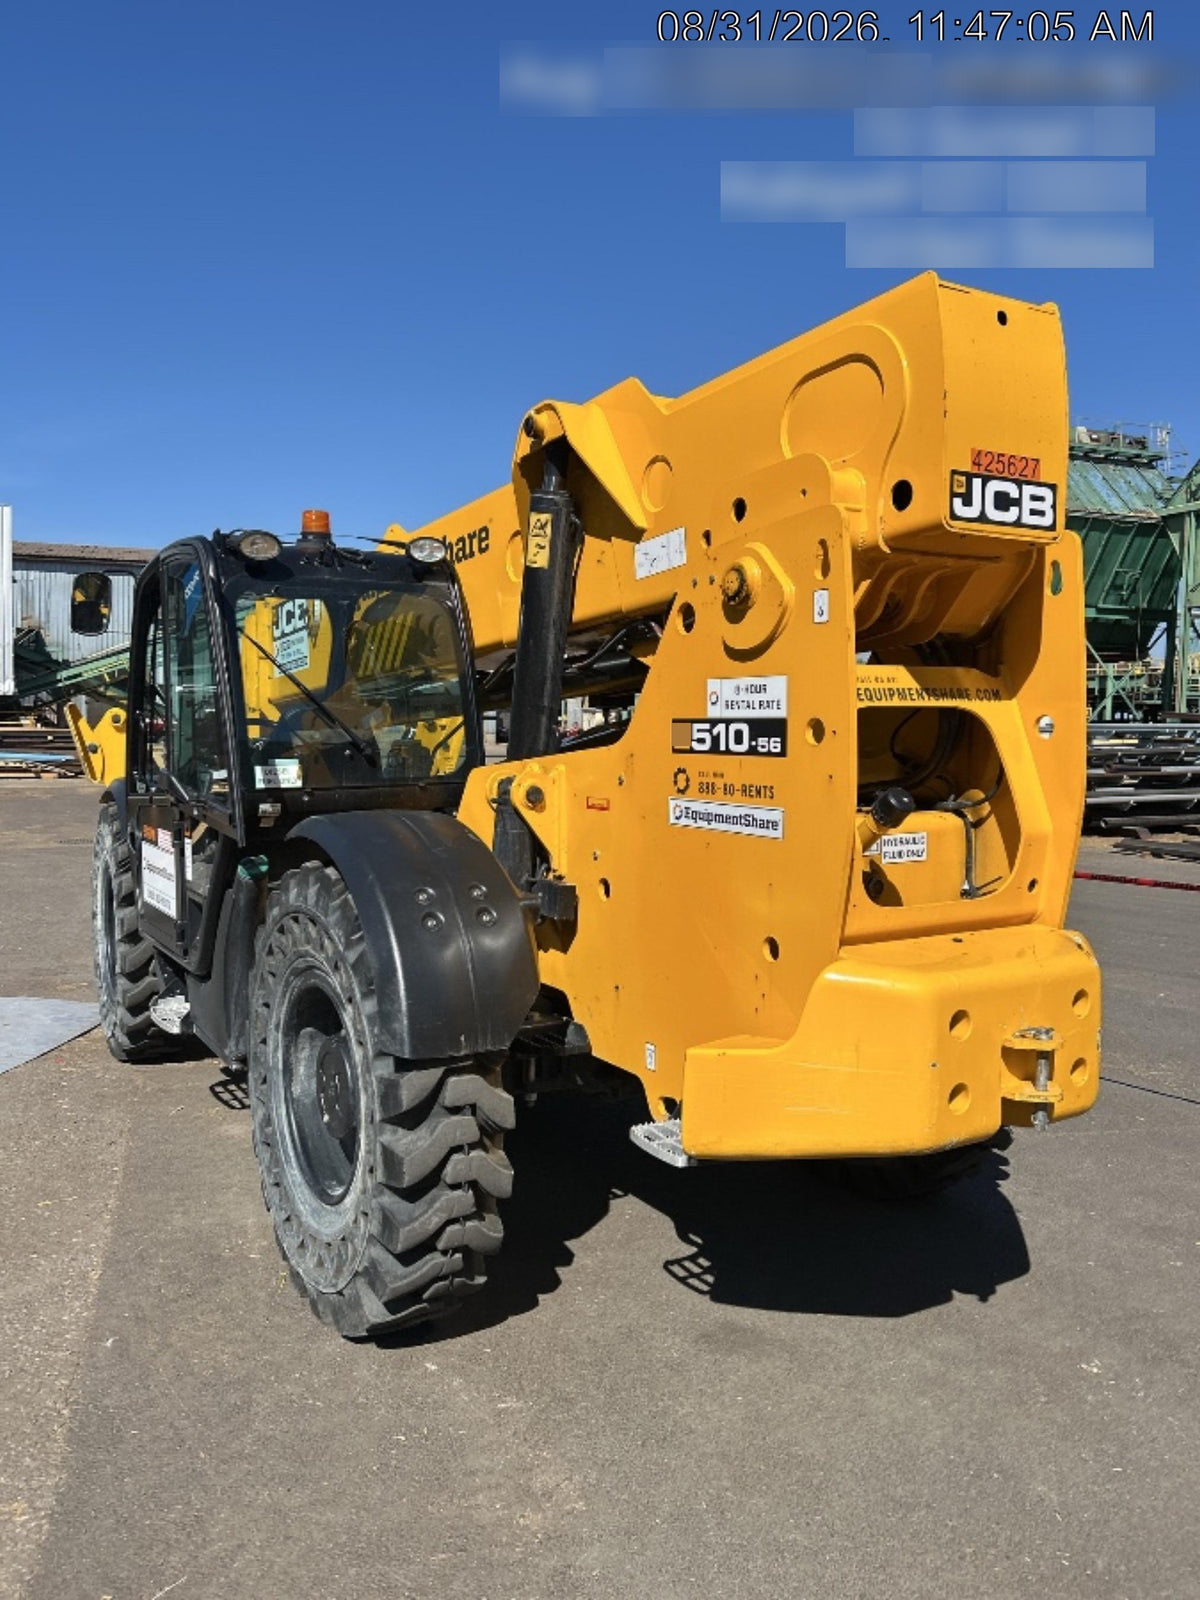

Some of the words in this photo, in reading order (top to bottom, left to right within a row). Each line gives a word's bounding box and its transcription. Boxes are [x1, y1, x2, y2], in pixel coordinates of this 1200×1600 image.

[972, 449, 1041, 479] 425627
[952, 477, 1055, 527] JCB
[758, 699, 782, 711] RATE
[683, 806, 780, 832] EquipmentShare
